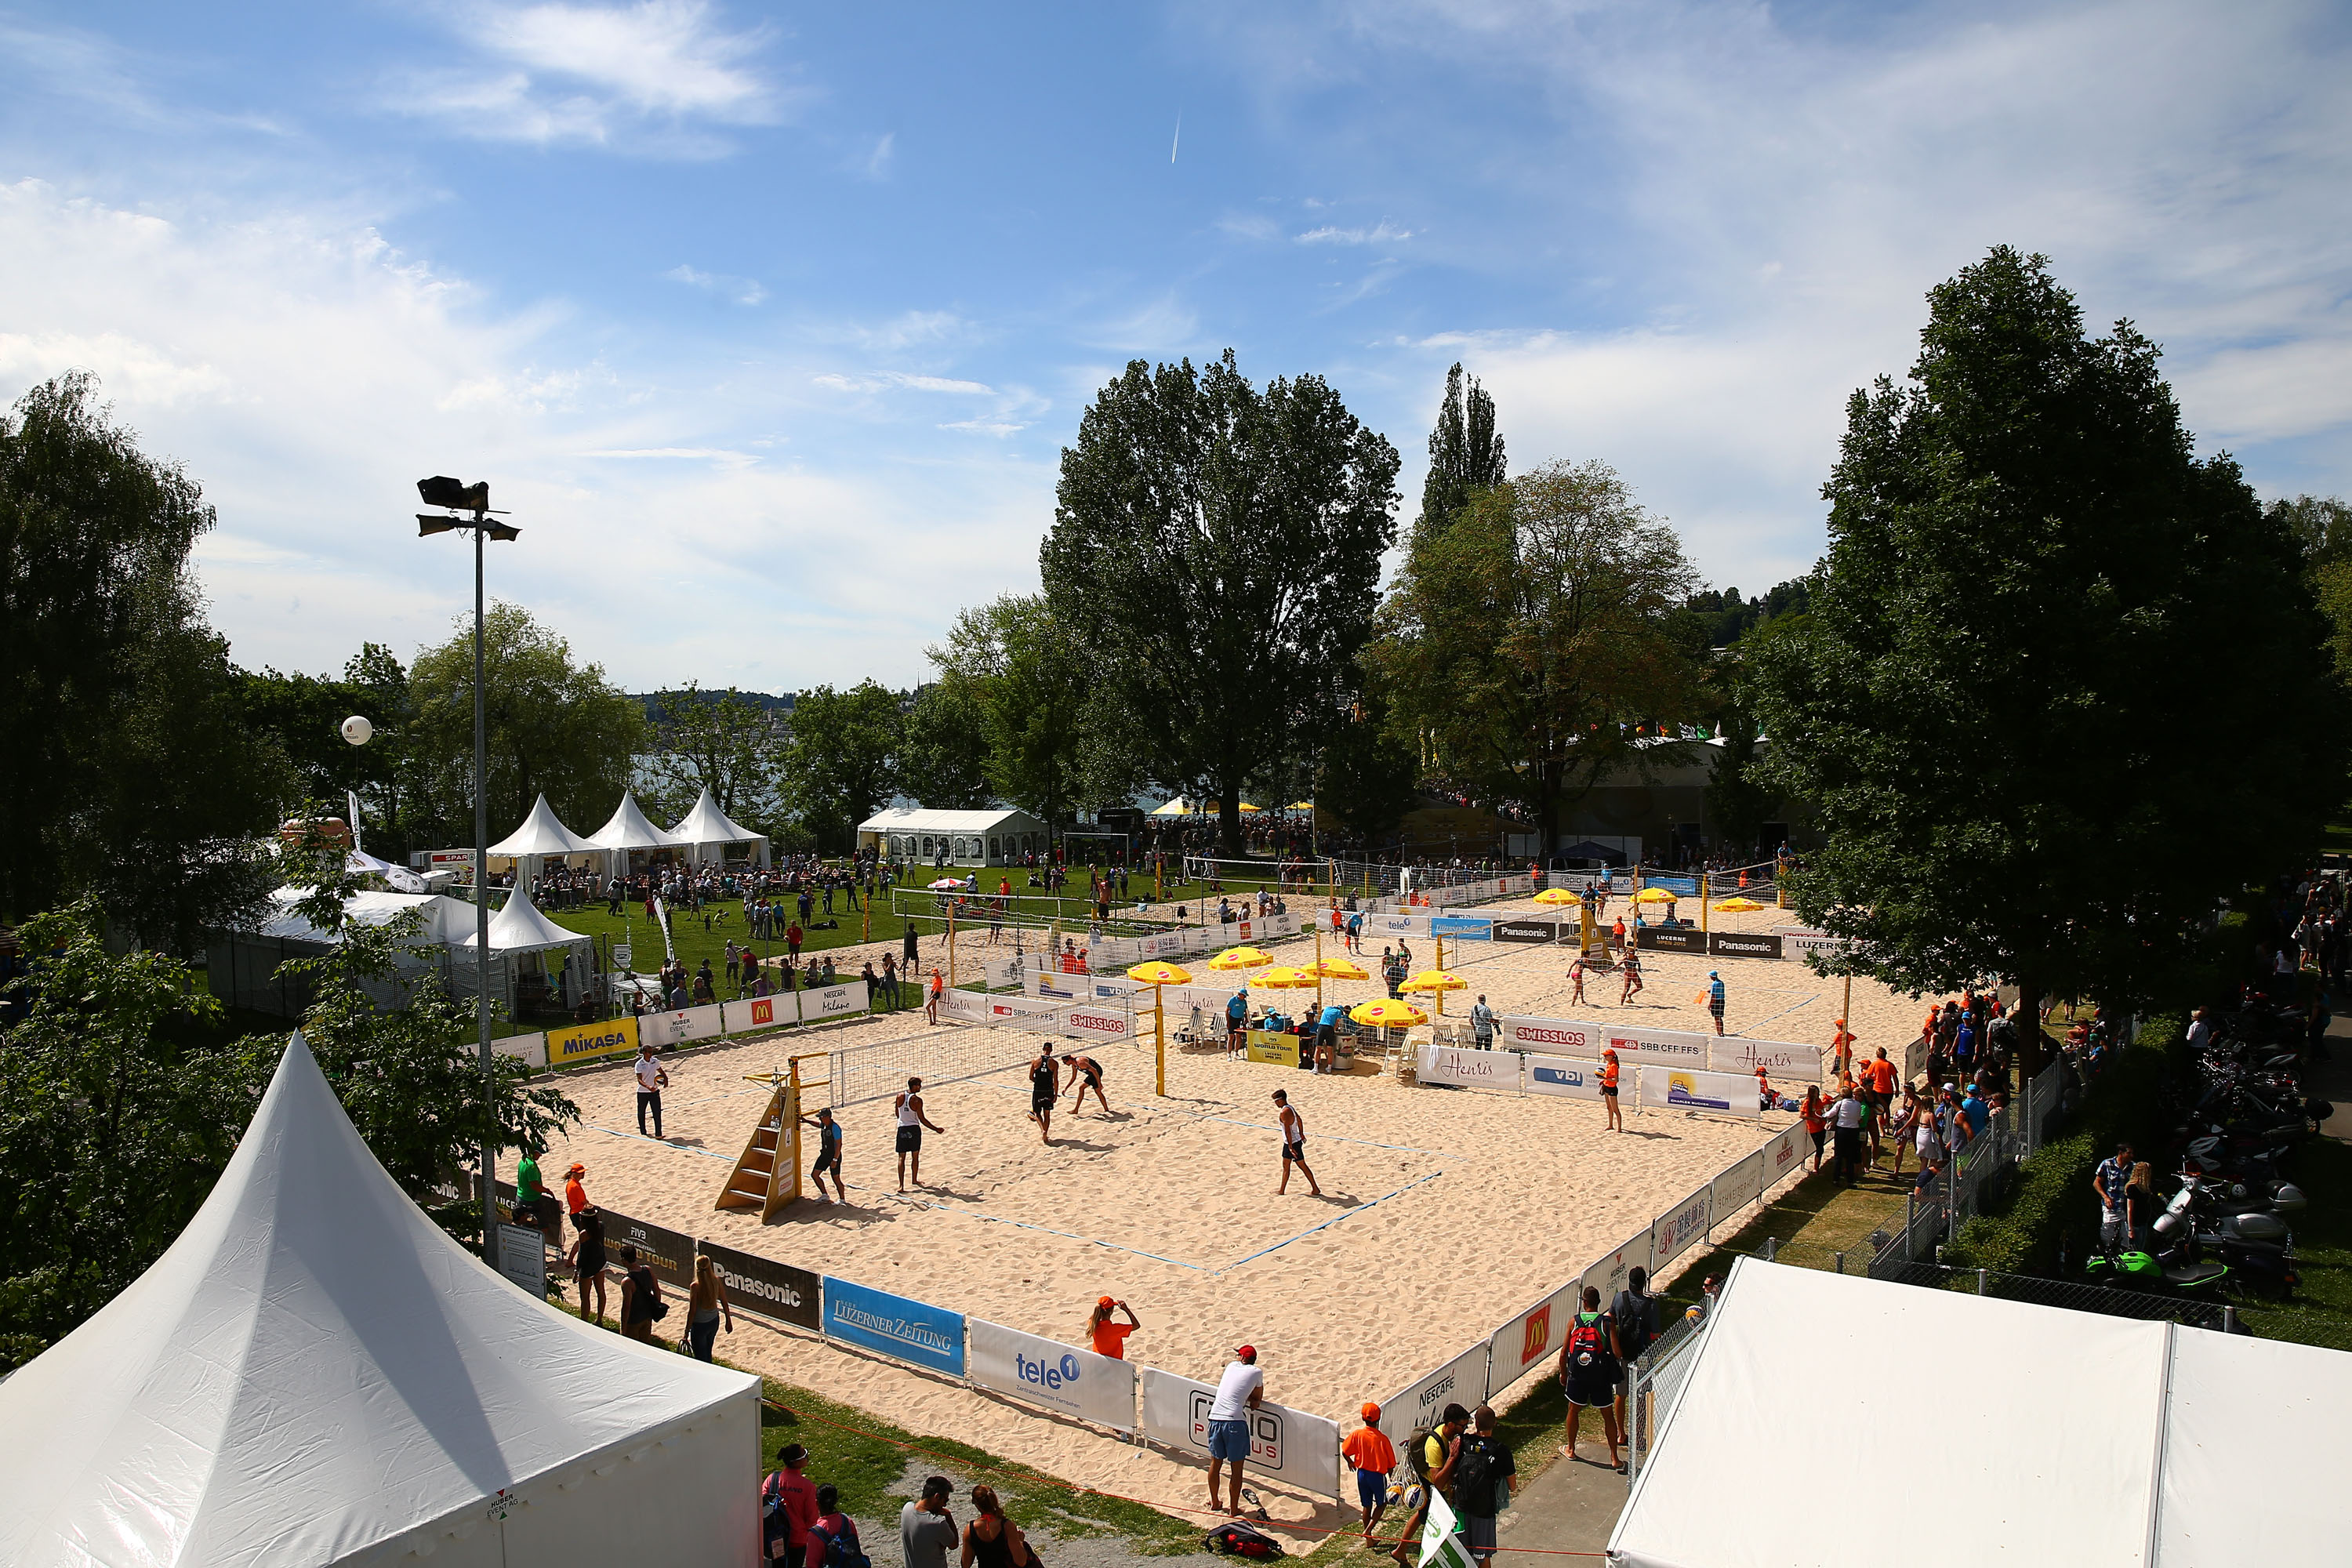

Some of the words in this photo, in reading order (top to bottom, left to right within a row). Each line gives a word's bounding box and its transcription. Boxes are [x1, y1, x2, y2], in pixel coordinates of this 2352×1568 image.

[1388, 920, 1405, 930] tele
[1501, 927, 1547, 937] Panasonic
[1719, 940, 1772, 952] Panasonic
[822, 1000, 850, 1013] Milano
[938, 991, 971, 1012] Henris
[1177, 989, 1214, 1010] Henris
[1071, 1014, 1124, 1033] SWISSLOS
[1516, 1026, 1585, 1046] SWISSLOS
[1682, 1046, 1699, 1054] FFS
[1735, 1044, 1791, 1070] Henris
[1440, 1052, 1492, 1079] Henris
[1555, 1071, 1581, 1081] vbl
[786, 1134, 790, 1145] 4
[630, 1226, 646, 1239] FIVB
[604, 1237, 643, 1259] WOD
[645, 1250, 677, 1272] TOUR
[713, 1262, 801, 1308] Panasonic
[833, 1299, 893, 1334] LUZERNER
[894, 1318, 952, 1351] ZEITUNG
[1016, 1353, 1062, 1390] tele
[1419, 1368, 1455, 1410] NESCAFÉ
[1055, 1396, 1081, 1409] Fernsehen
[491, 1494, 514, 1508] HUBER
[487, 1503, 507, 1517] EVENT
